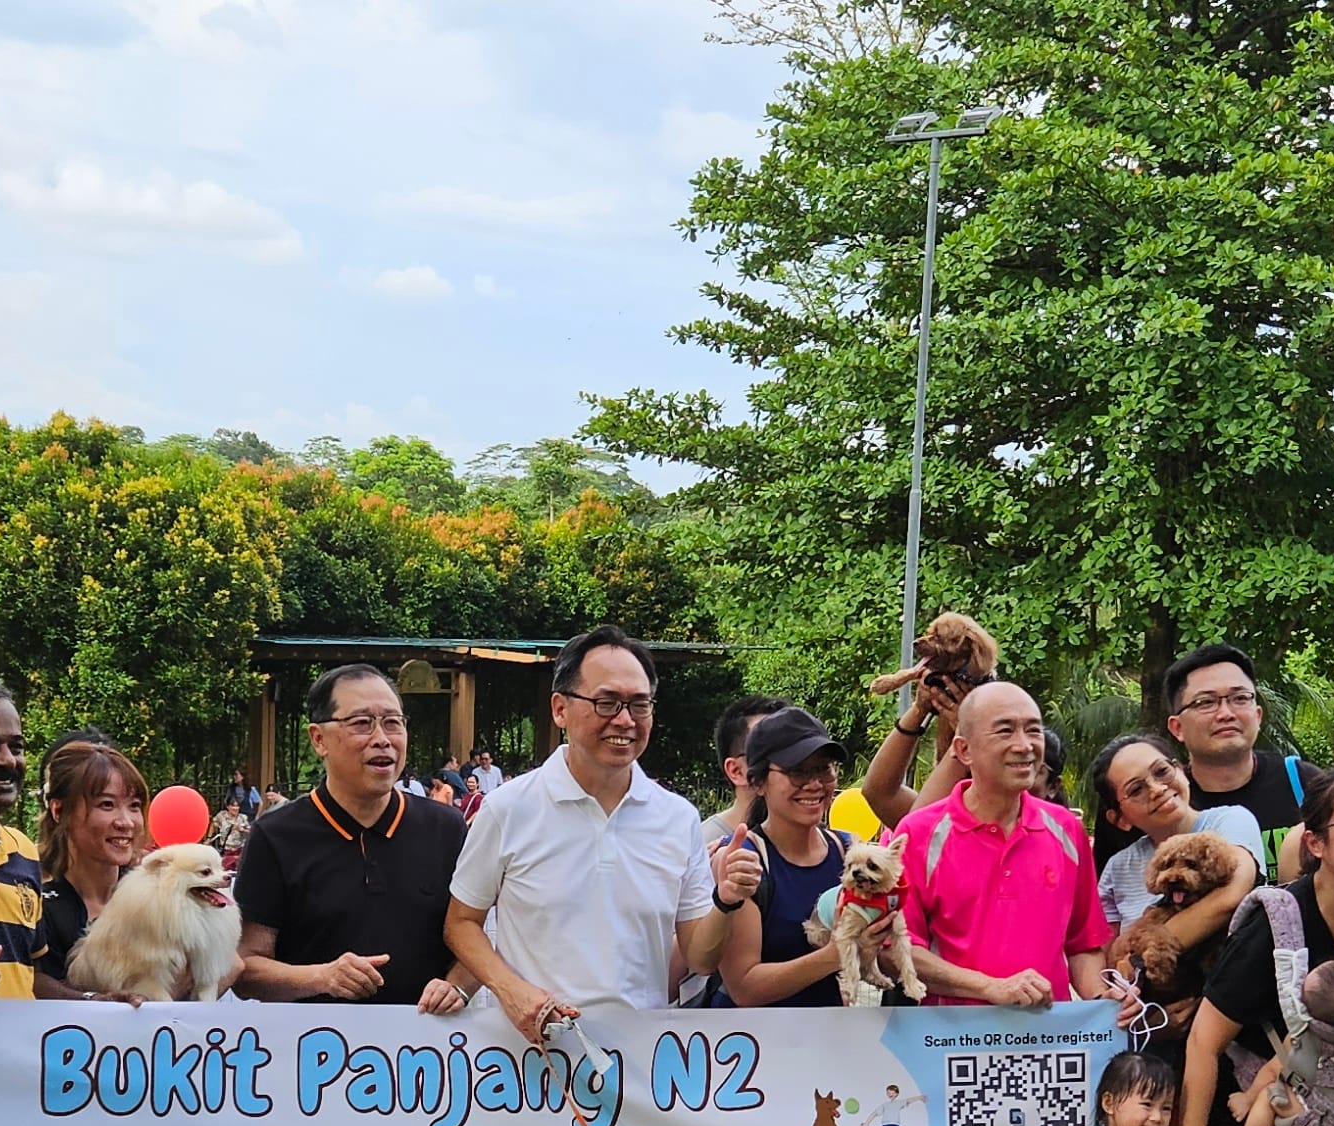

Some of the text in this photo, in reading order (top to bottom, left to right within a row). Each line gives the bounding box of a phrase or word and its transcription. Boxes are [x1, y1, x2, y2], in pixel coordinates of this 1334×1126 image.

[924, 1030, 1113, 1048] Scan the QR Code to register!
[40, 1024, 273, 1118] Bukit
[651, 1030, 765, 1113] N2
